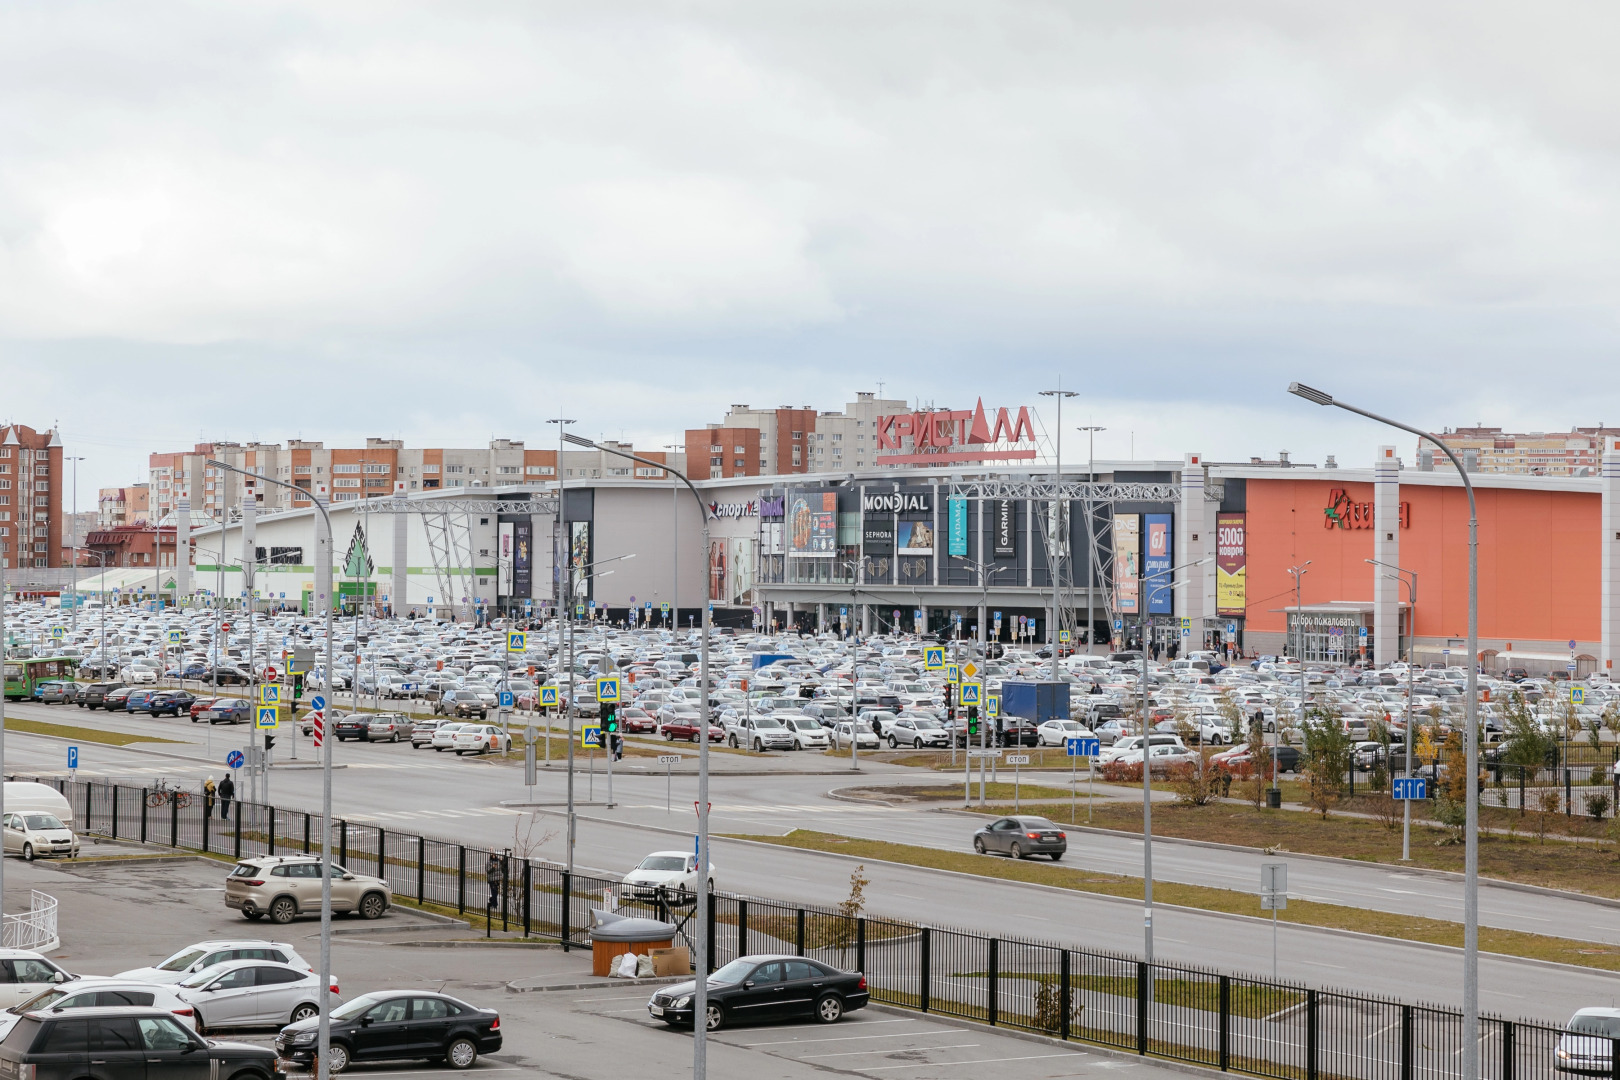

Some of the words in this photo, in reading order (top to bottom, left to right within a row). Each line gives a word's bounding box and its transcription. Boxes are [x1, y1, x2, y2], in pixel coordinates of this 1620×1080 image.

[864, 493, 929, 513] MONDIAL
[1001, 499, 1009, 546] GARMIN
[1114, 519, 1136, 531] DNS
[865, 531, 892, 539] SEPHORA
[1151, 531, 1164, 549] GJ
[1219, 528, 1243, 545] 5000
[1291, 614, 1313, 627] Добро
[1314, 617, 1355, 627] пожаловать
